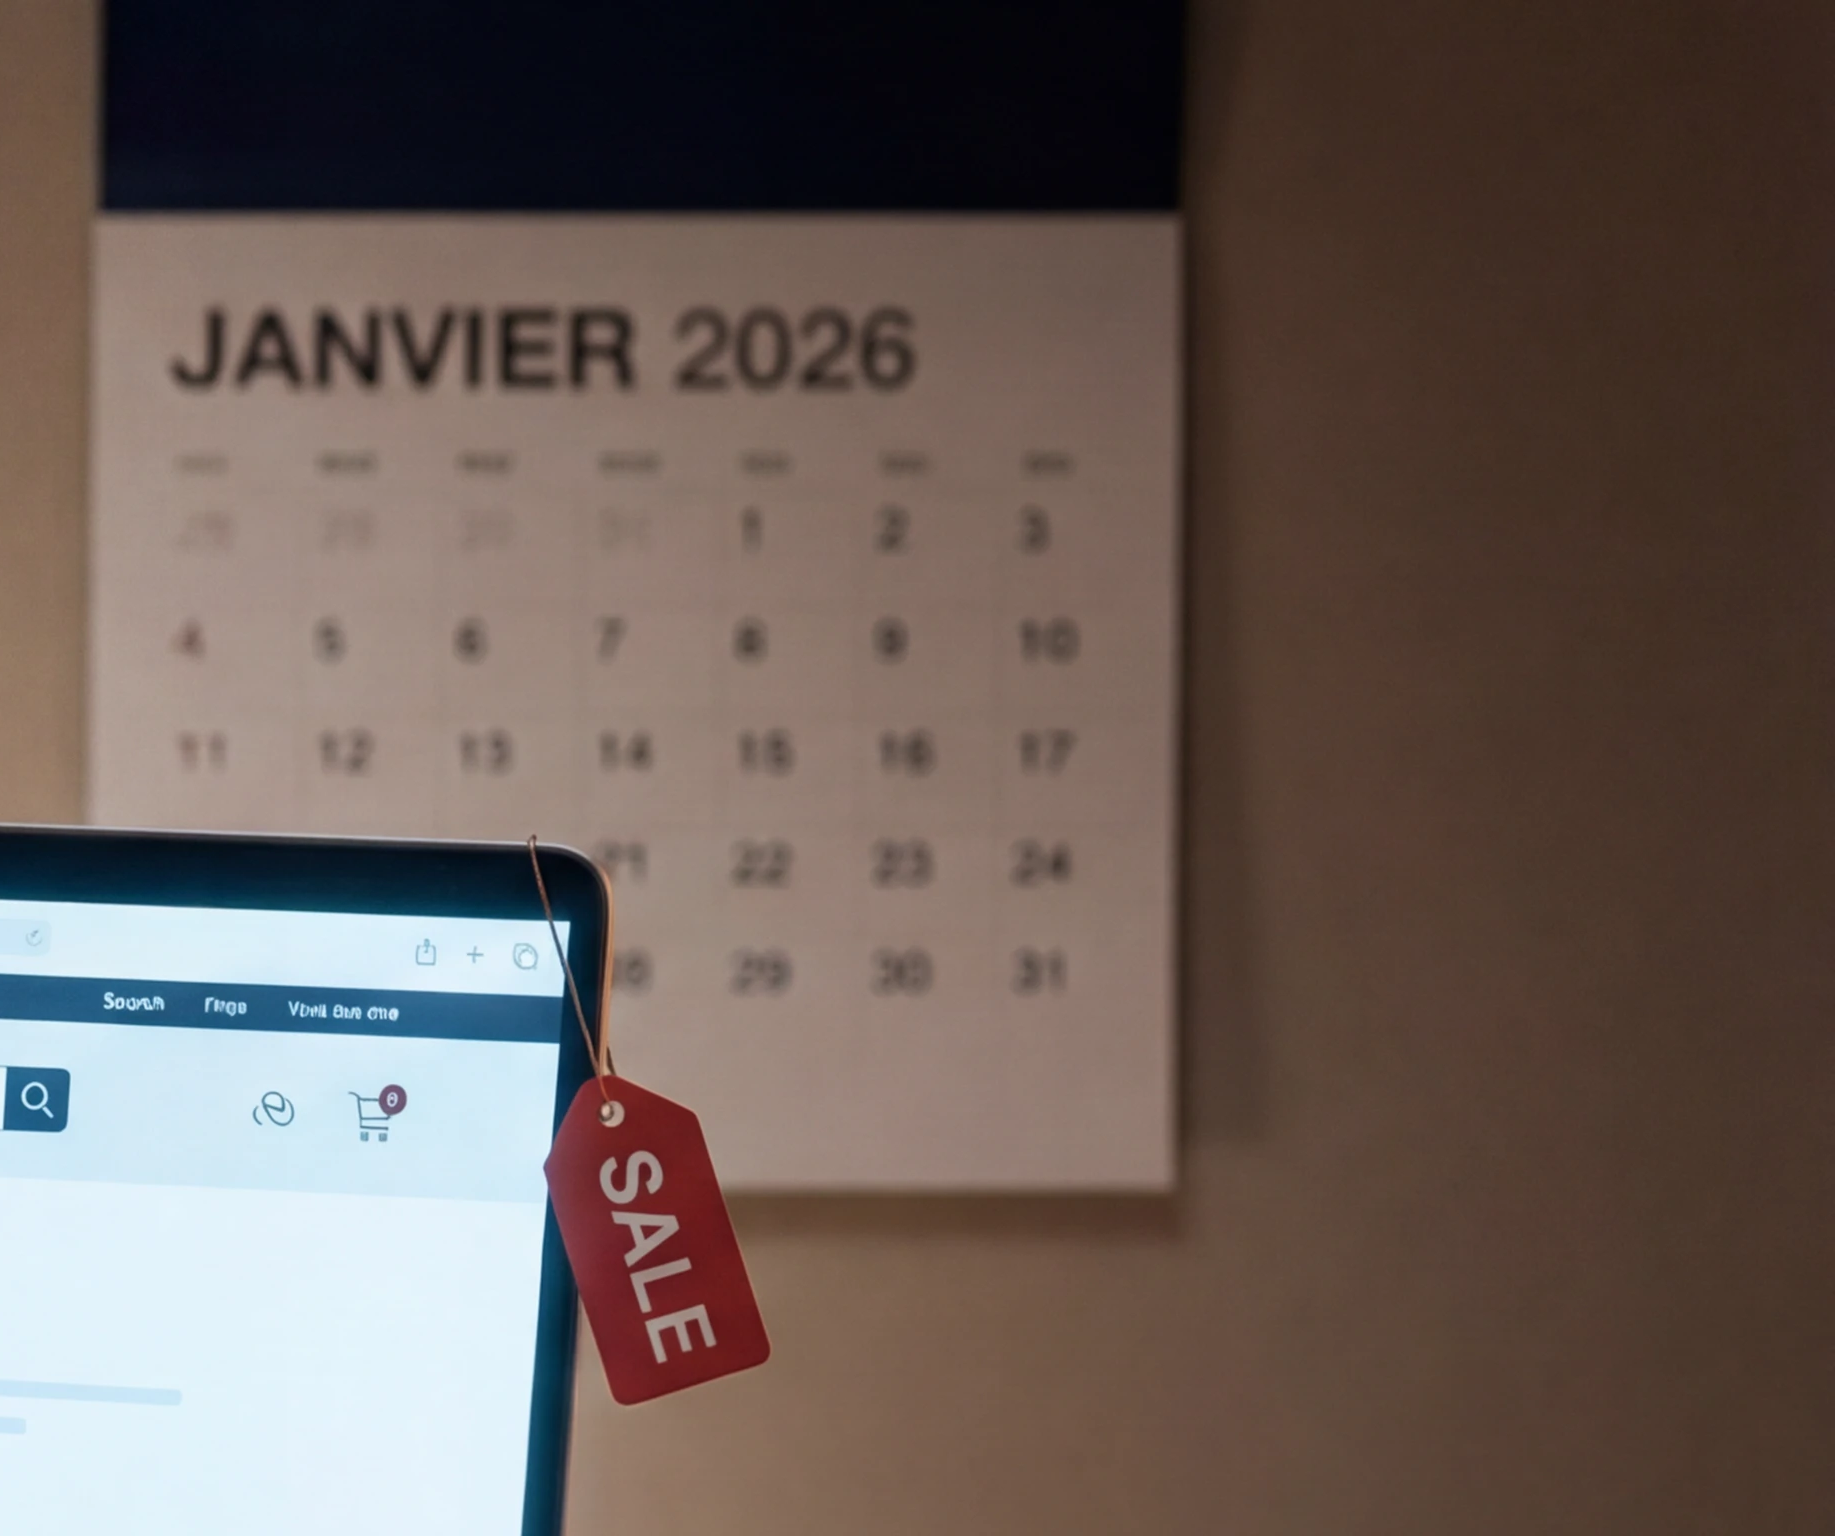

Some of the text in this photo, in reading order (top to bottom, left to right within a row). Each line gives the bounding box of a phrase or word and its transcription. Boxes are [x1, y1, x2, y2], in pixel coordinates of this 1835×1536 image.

[170, 306, 919, 393] JANVIER 2026
[874, 504, 911, 556] 2
[1019, 505, 1053, 556] 3
[172, 617, 207, 662] 4
[452, 617, 488, 663] 6
[596, 614, 628, 662] 7
[1017, 616, 1082, 666] 10
[175, 727, 1078, 777] 11 12 13 14 15 16 17
[730, 841, 794, 889] 22
[872, 840, 935, 889] 23
[1013, 841, 1075, 889] 24
[731, 949, 794, 997] 29
[874, 949, 934, 996] 30
[1014, 948, 1068, 996] 31
[599, 1150, 717, 1364] SALE
